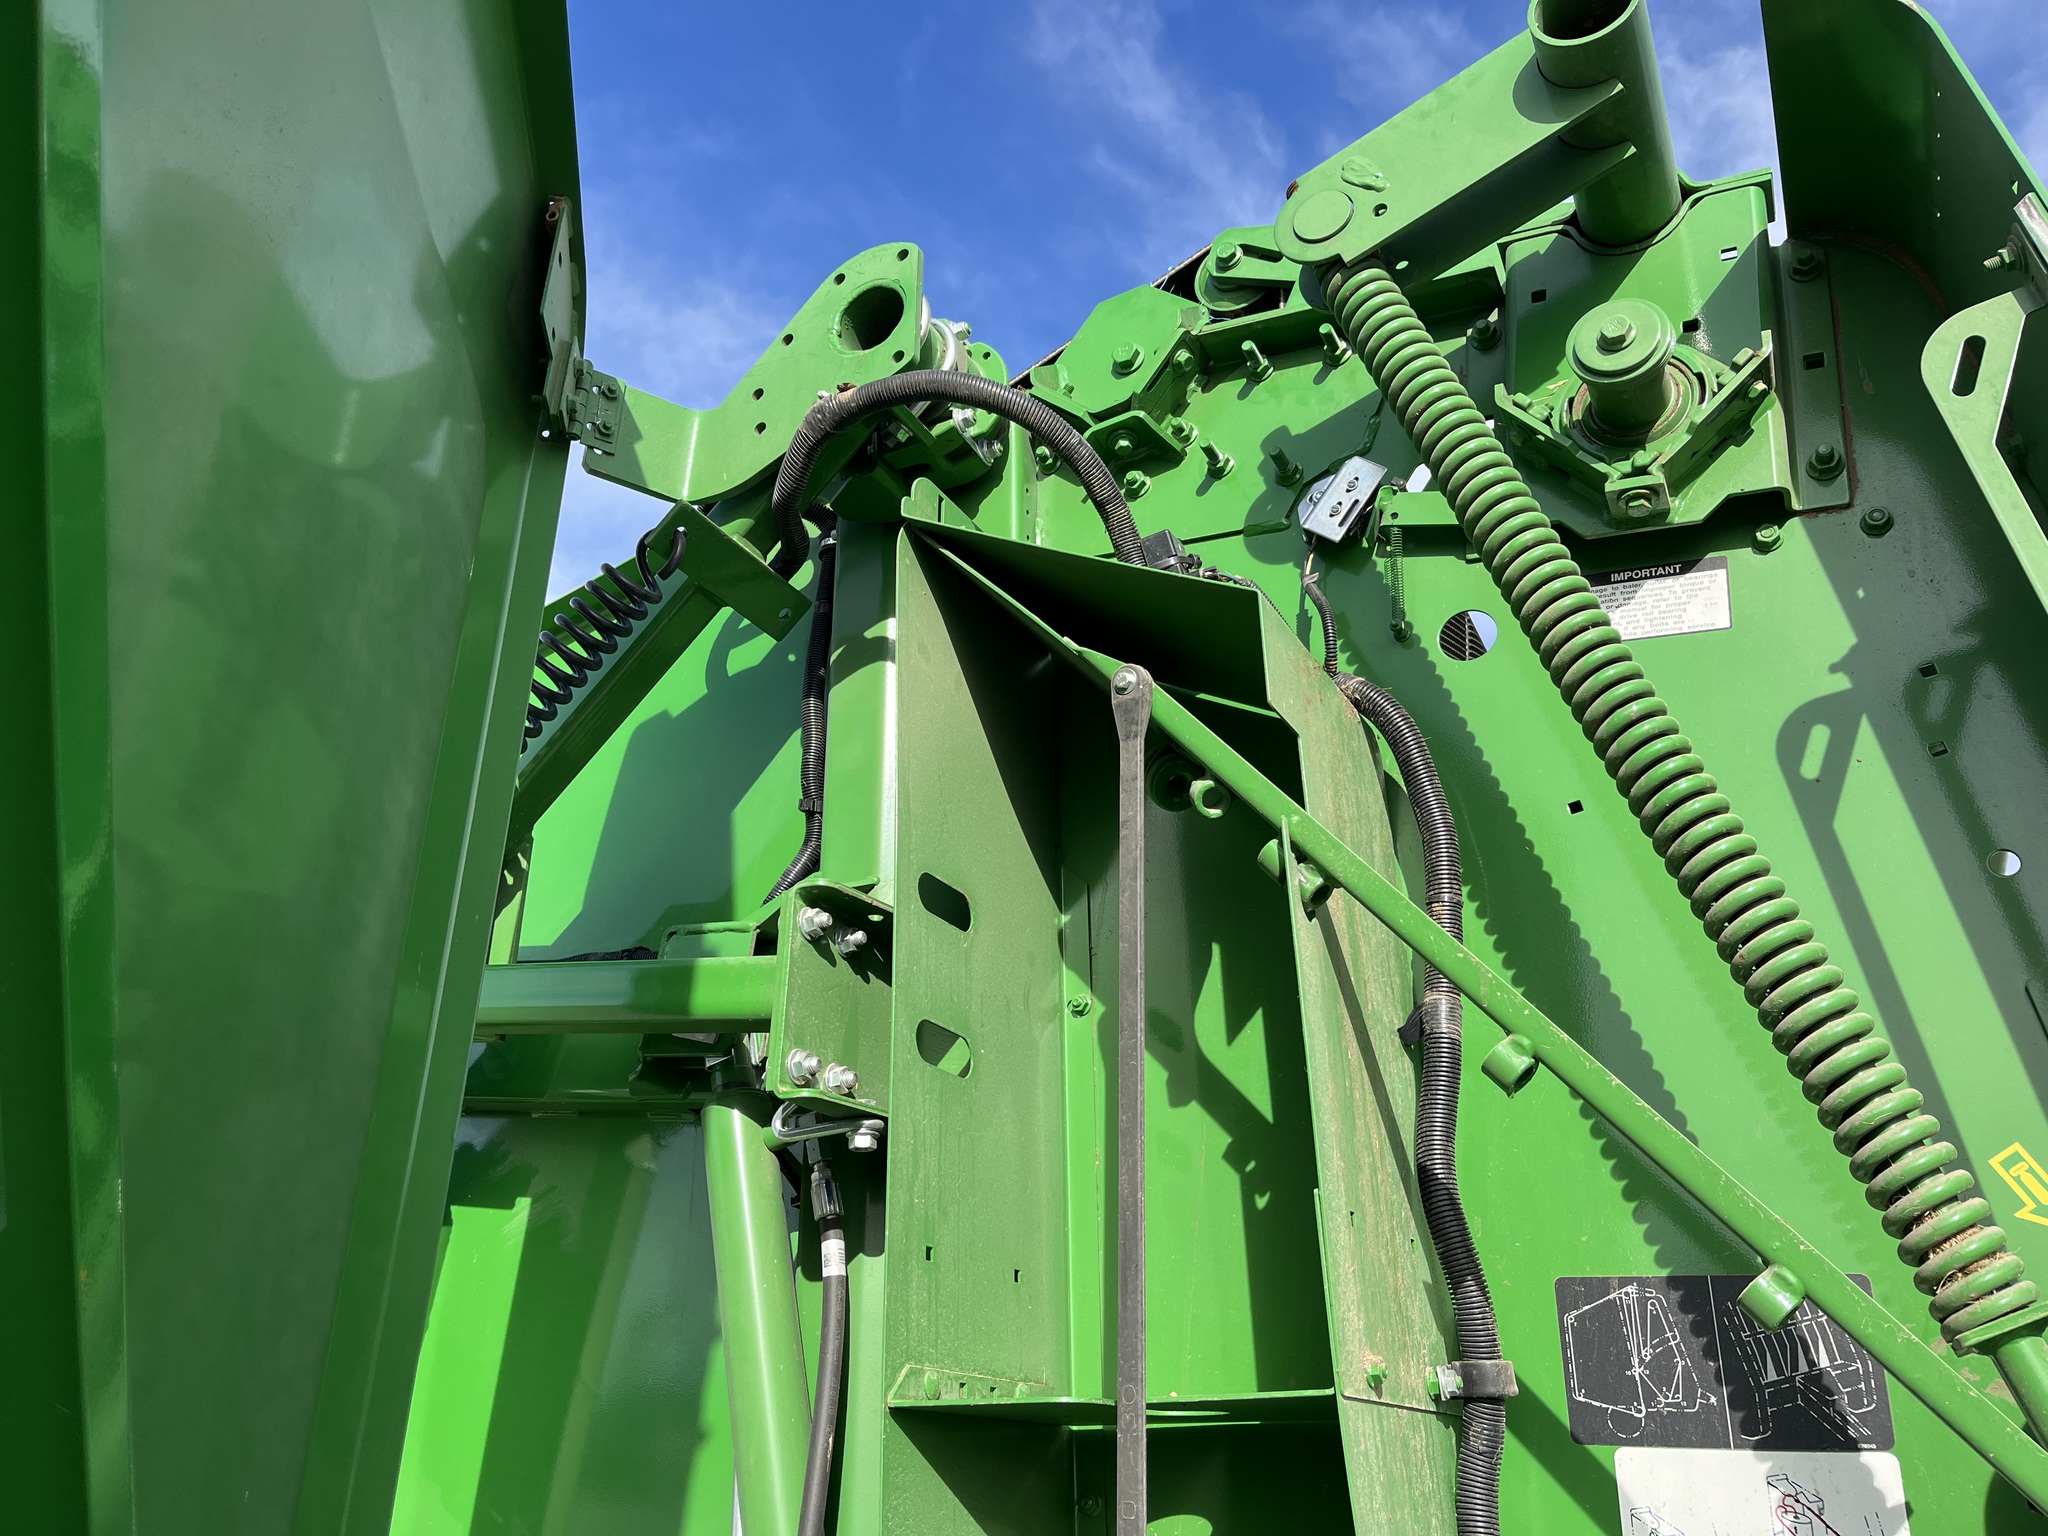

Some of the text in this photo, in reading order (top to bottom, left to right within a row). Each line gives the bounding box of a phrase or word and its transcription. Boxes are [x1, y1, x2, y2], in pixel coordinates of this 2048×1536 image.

[1611, 564, 1682, 582] IMPORTANT
[1622, 582, 1644, 590] baler,
[1684, 572, 1718, 581] bearings
[1641, 583, 1676, 593] improper
[1679, 580, 1704, 589] torque
[1681, 584, 1711, 595] prevent
[1620, 605, 1647, 614] manual
[1665, 600, 1691, 609] proper
[1658, 607, 1687, 616] bearing
[1644, 614, 1683, 624] tightening
[1632, 624, 1646, 632] any
[1650, 620, 1669, 628] bolts
[1641, 625, 1684, 636] performing
[1687, 621, 1719, 630] service.
